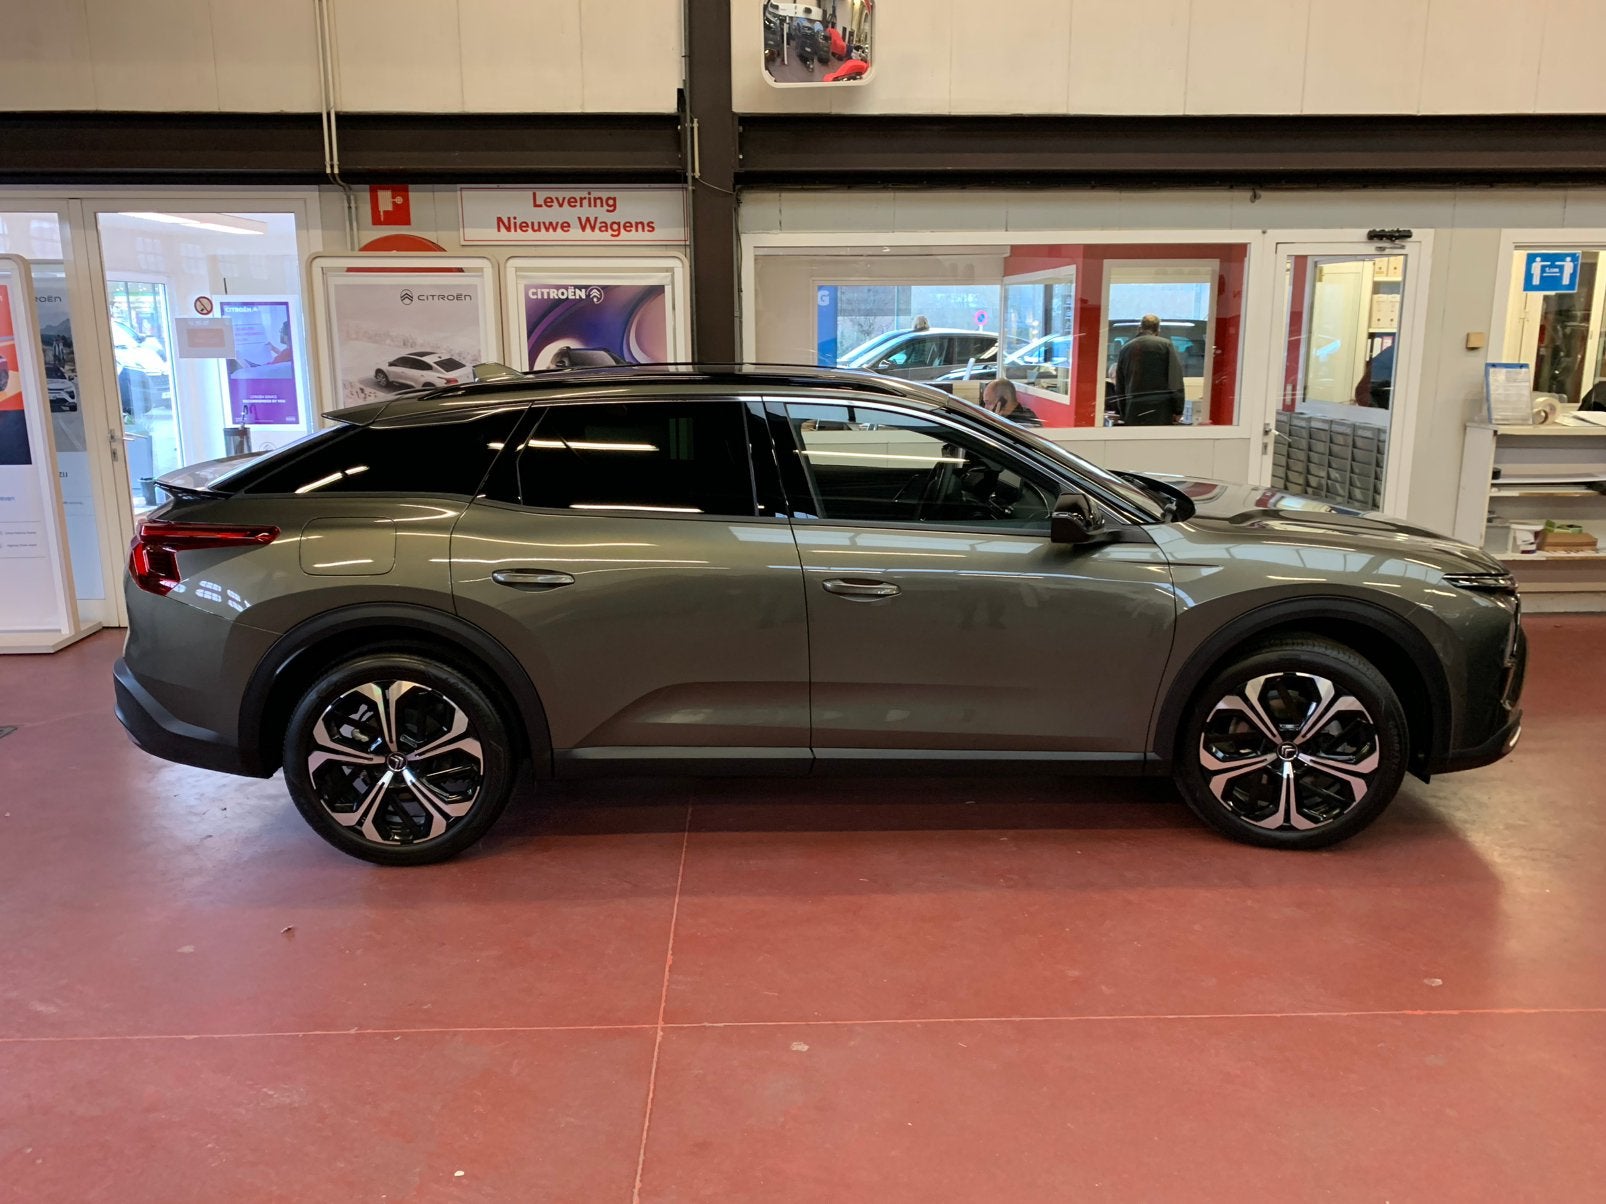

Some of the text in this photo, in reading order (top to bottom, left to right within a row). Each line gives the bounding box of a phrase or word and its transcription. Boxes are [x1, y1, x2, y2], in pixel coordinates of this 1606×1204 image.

[532, 191, 618, 213] Levering
[496, 216, 656, 238] Nieuwe Wagens
[417, 293, 473, 302] CITROËN
[528, 286, 586, 300] CITROËN
